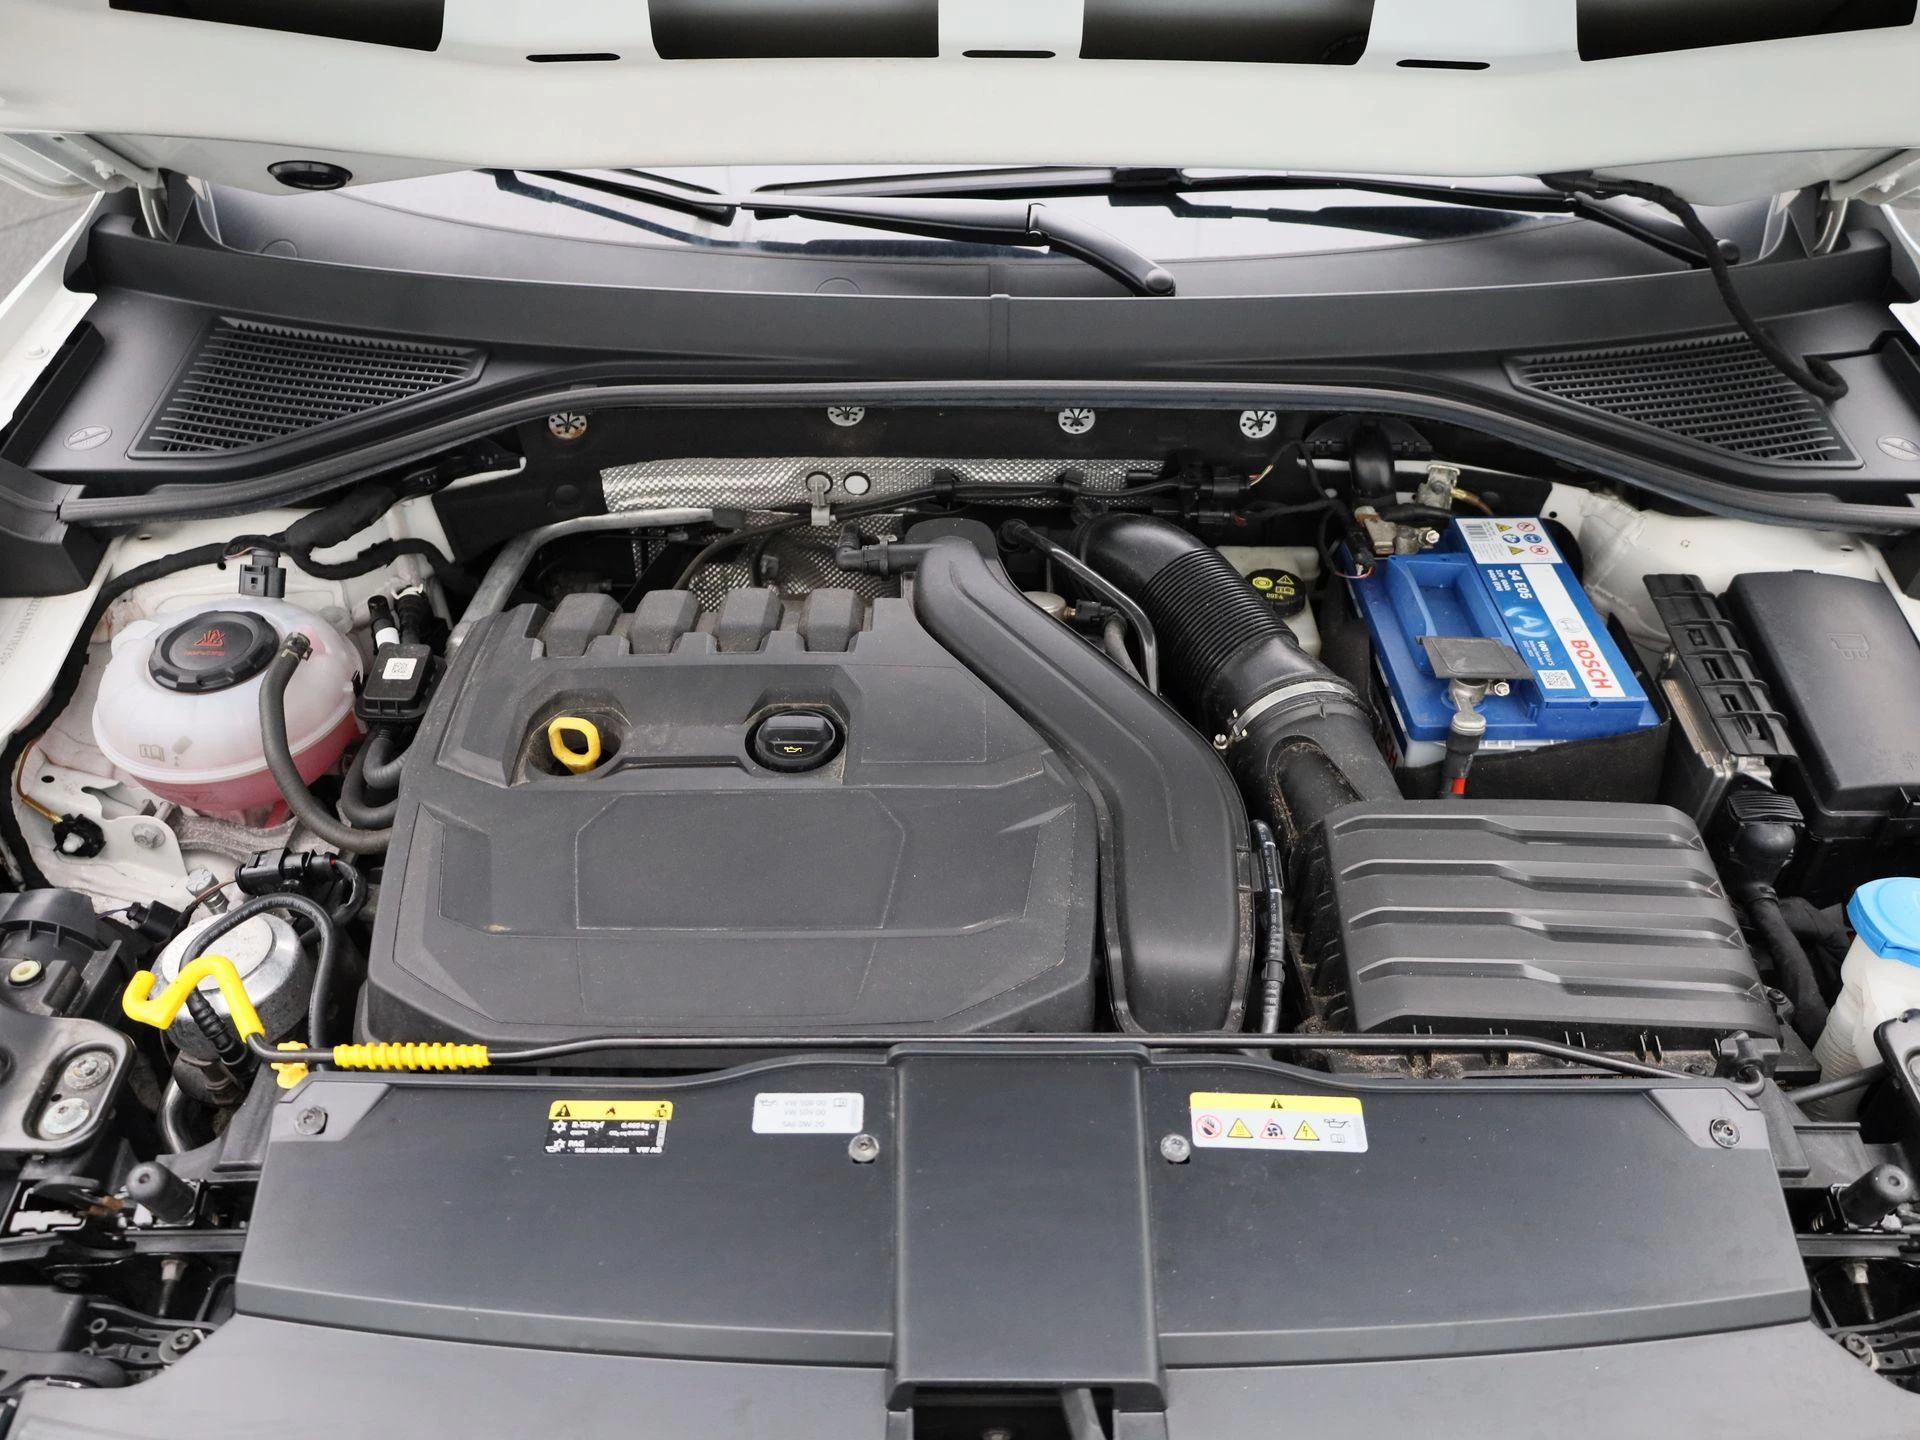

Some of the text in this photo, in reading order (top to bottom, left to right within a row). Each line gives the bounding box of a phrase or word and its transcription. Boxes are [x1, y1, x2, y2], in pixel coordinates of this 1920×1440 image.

[1508, 569, 1533, 600] S4 E05
[1569, 639, 1613, 689] BOSCH
